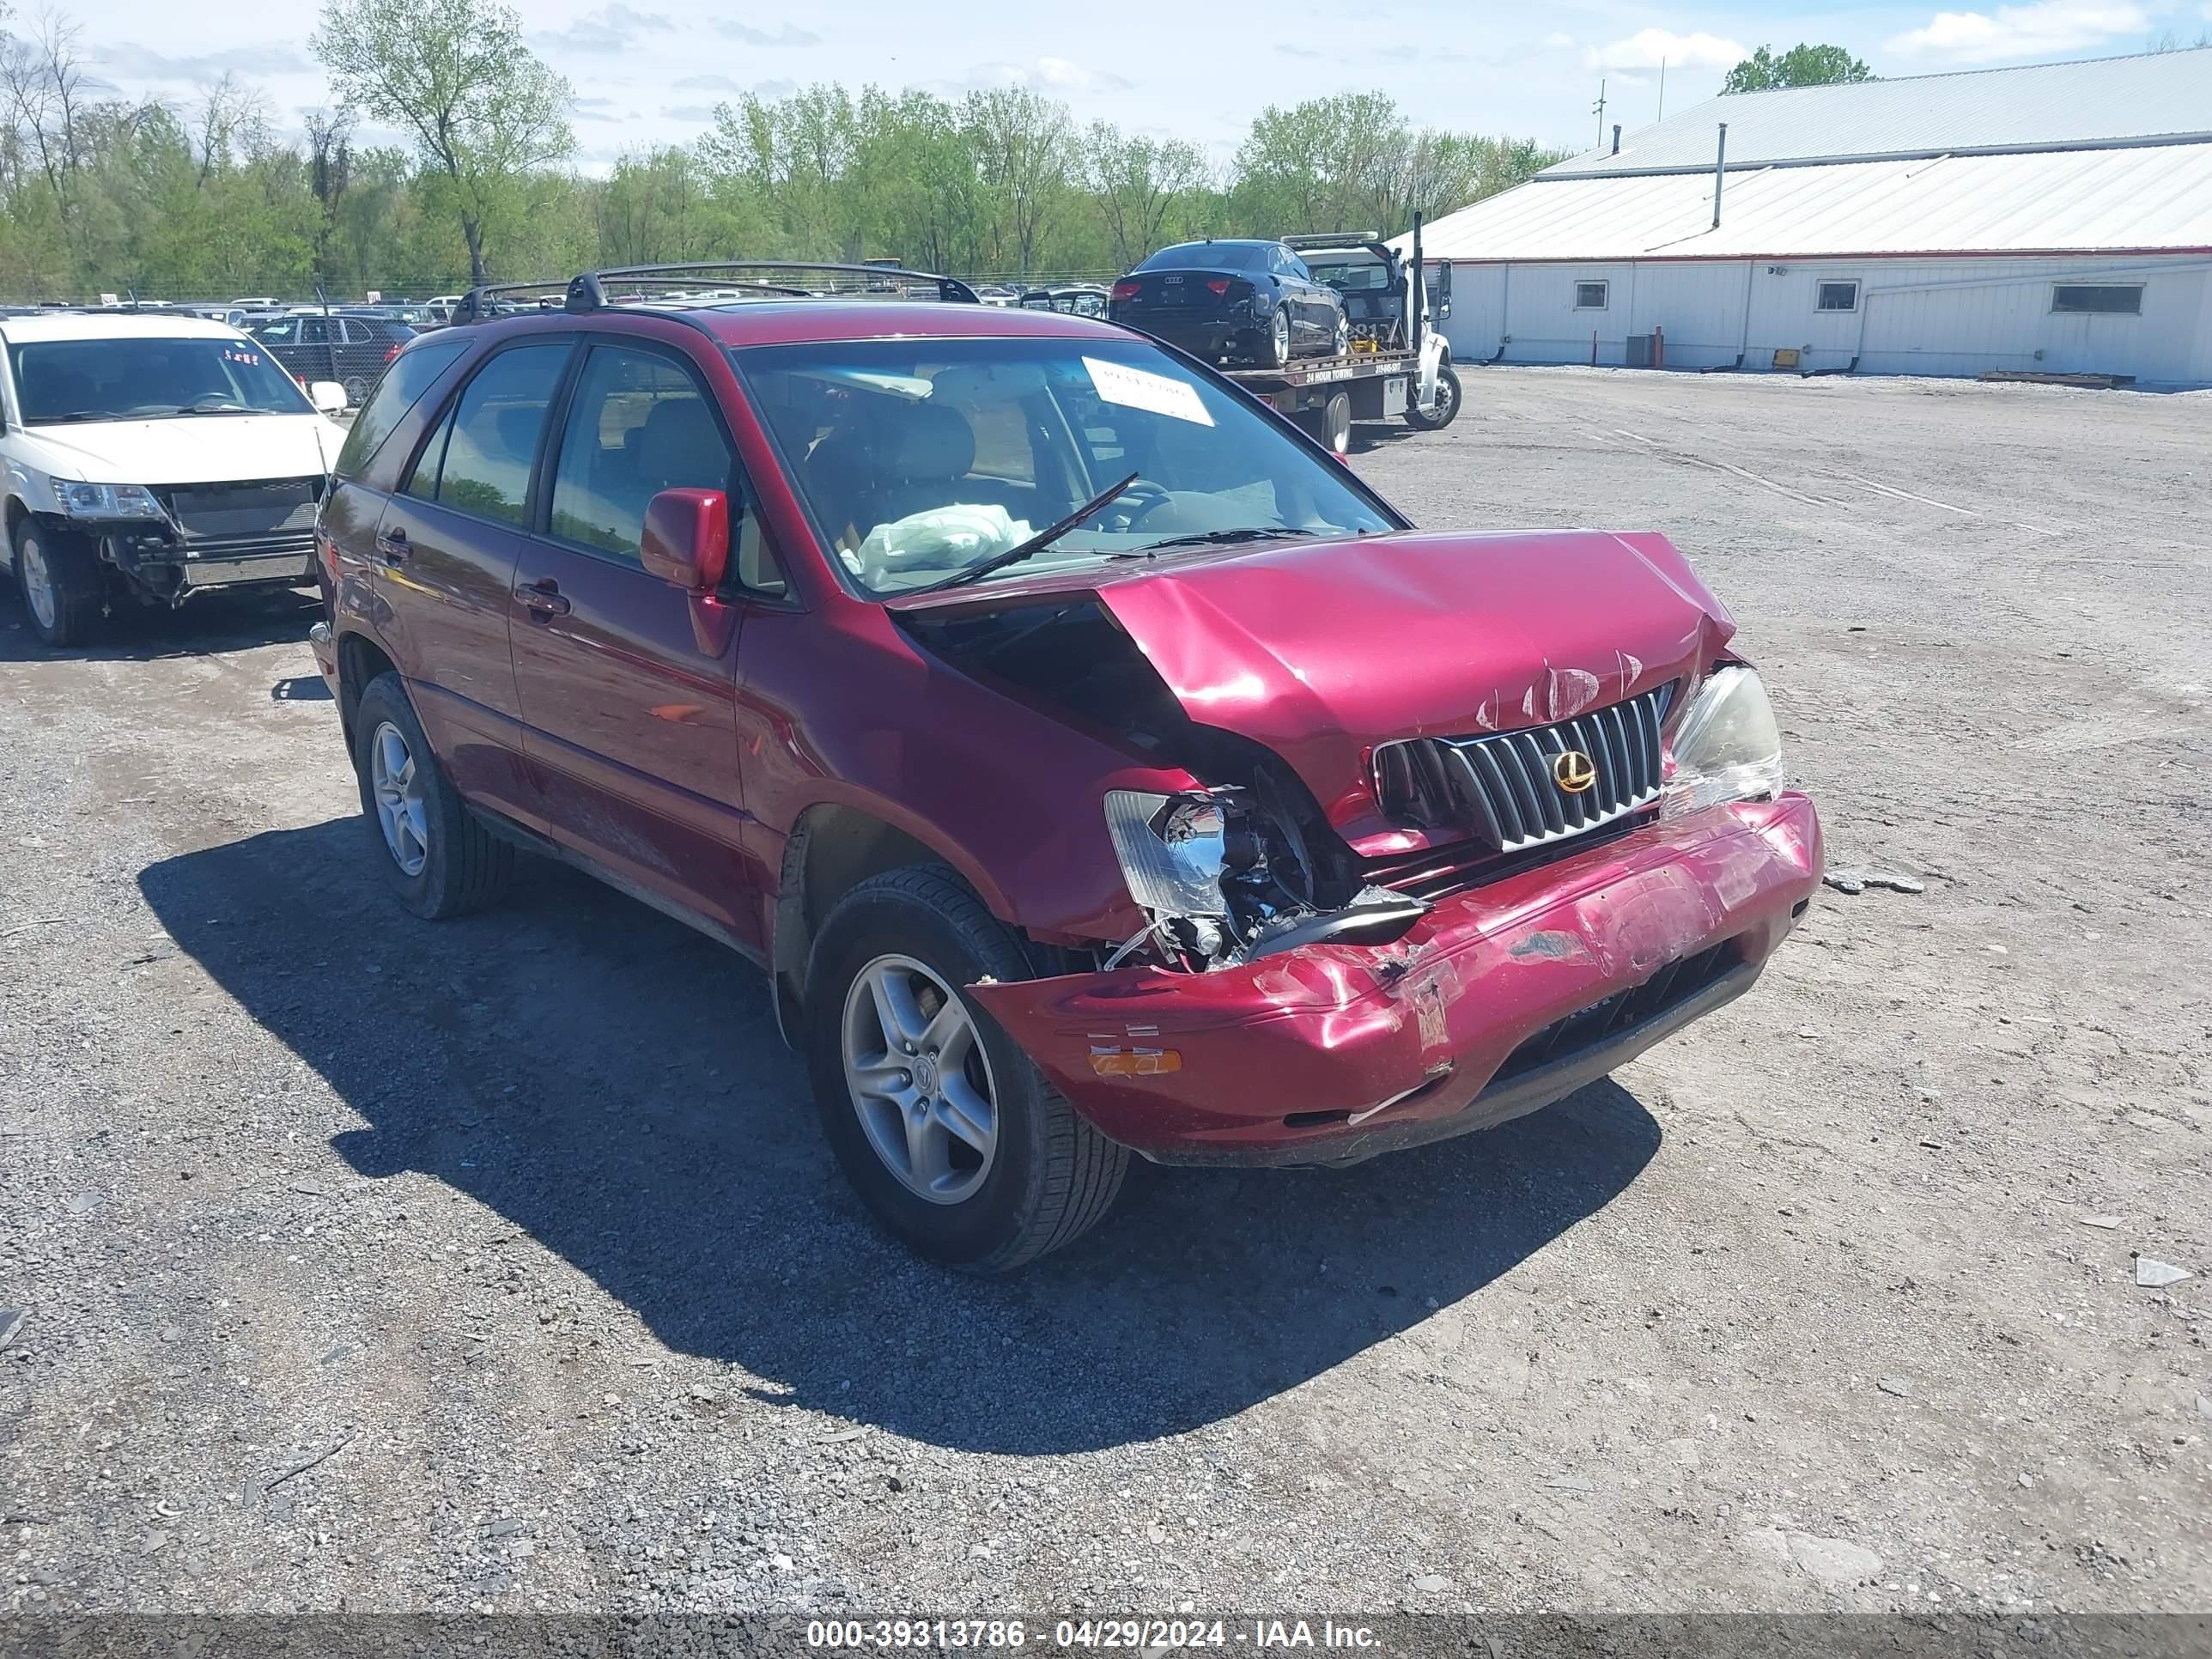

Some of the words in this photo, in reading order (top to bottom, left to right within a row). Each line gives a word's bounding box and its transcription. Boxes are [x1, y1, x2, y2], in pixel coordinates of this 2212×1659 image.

[1306, 373, 1314, 383] 24
[1315, 371, 1332, 382] HOUR
[1332, 368, 1353, 379] TOWING
